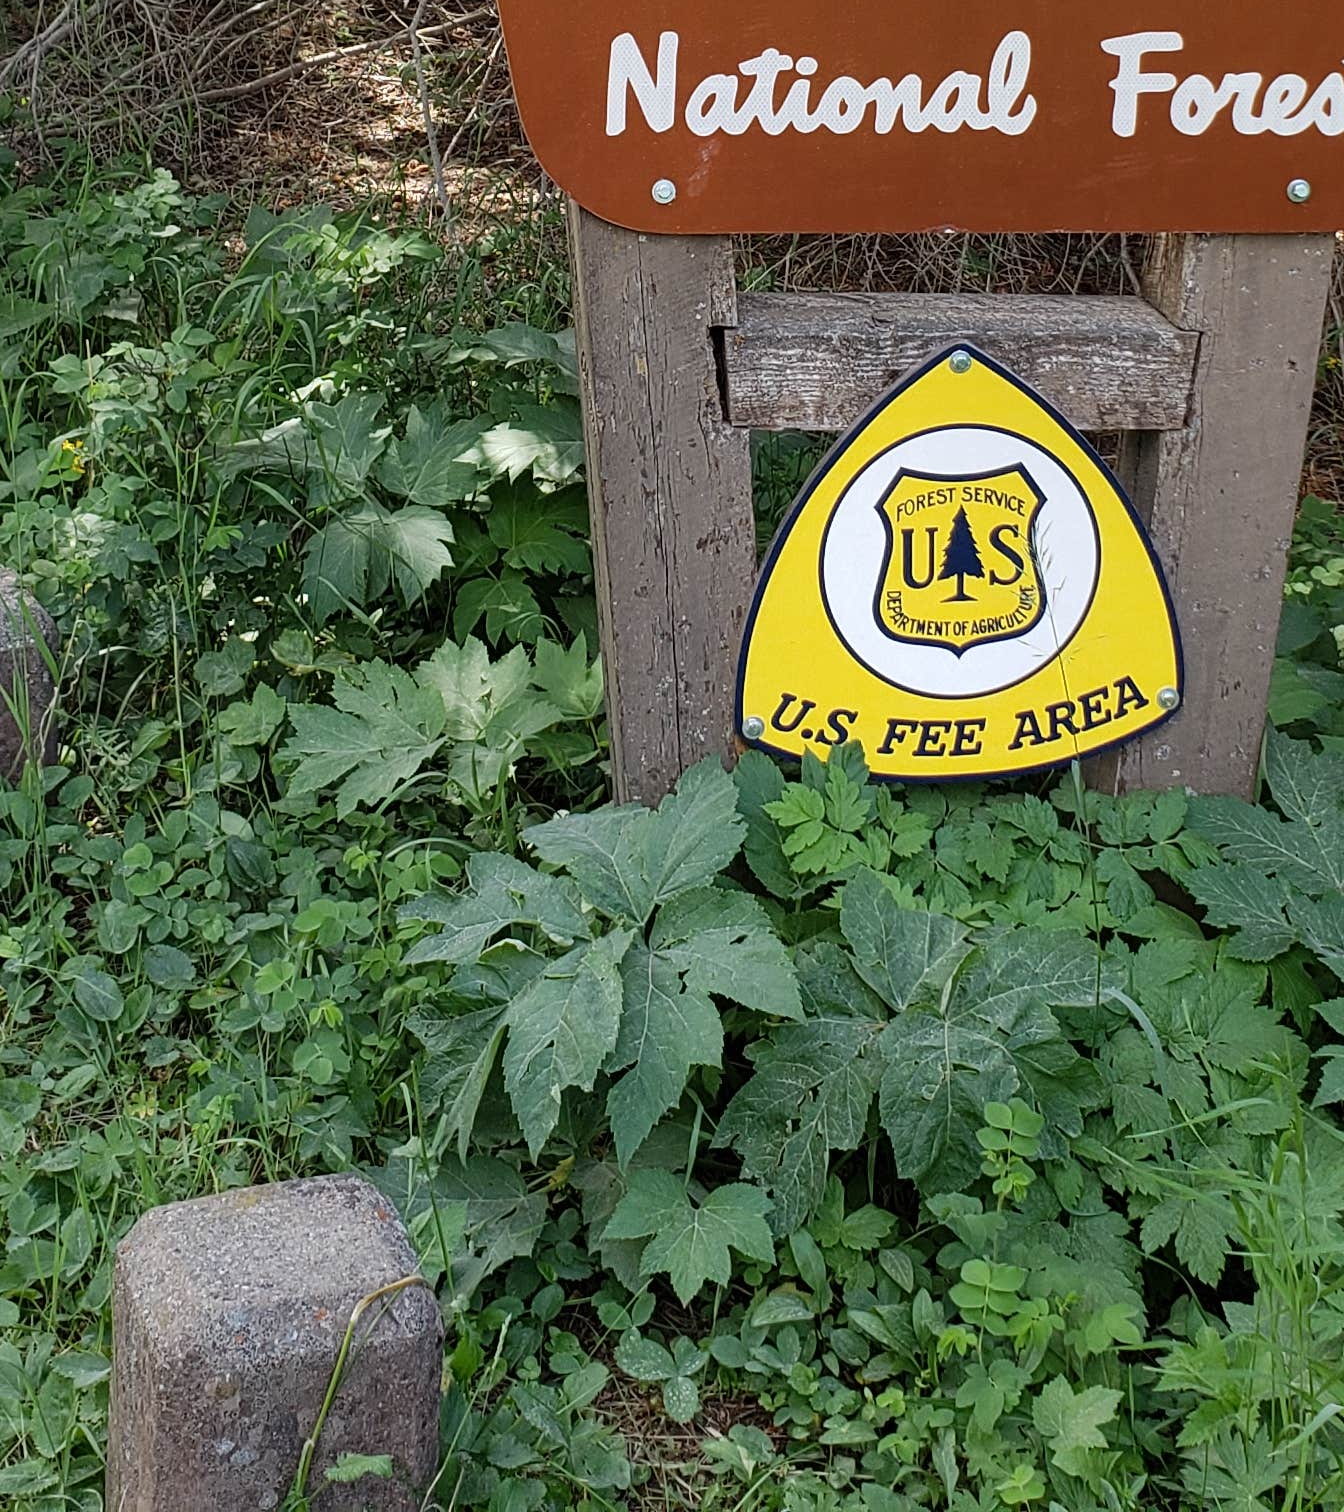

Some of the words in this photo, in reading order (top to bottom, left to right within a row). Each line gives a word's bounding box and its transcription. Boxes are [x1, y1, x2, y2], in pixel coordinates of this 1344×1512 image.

[605, 30, 1038, 138] National
[896, 487, 957, 523] FOREST
[961, 486, 1026, 517] SERVICE
[887, 590, 952, 637] DEPARTMENT
[953, 621, 968, 637] OF
[876, 718, 987, 757] FEE
[1007, 675, 1150, 751] AREA
